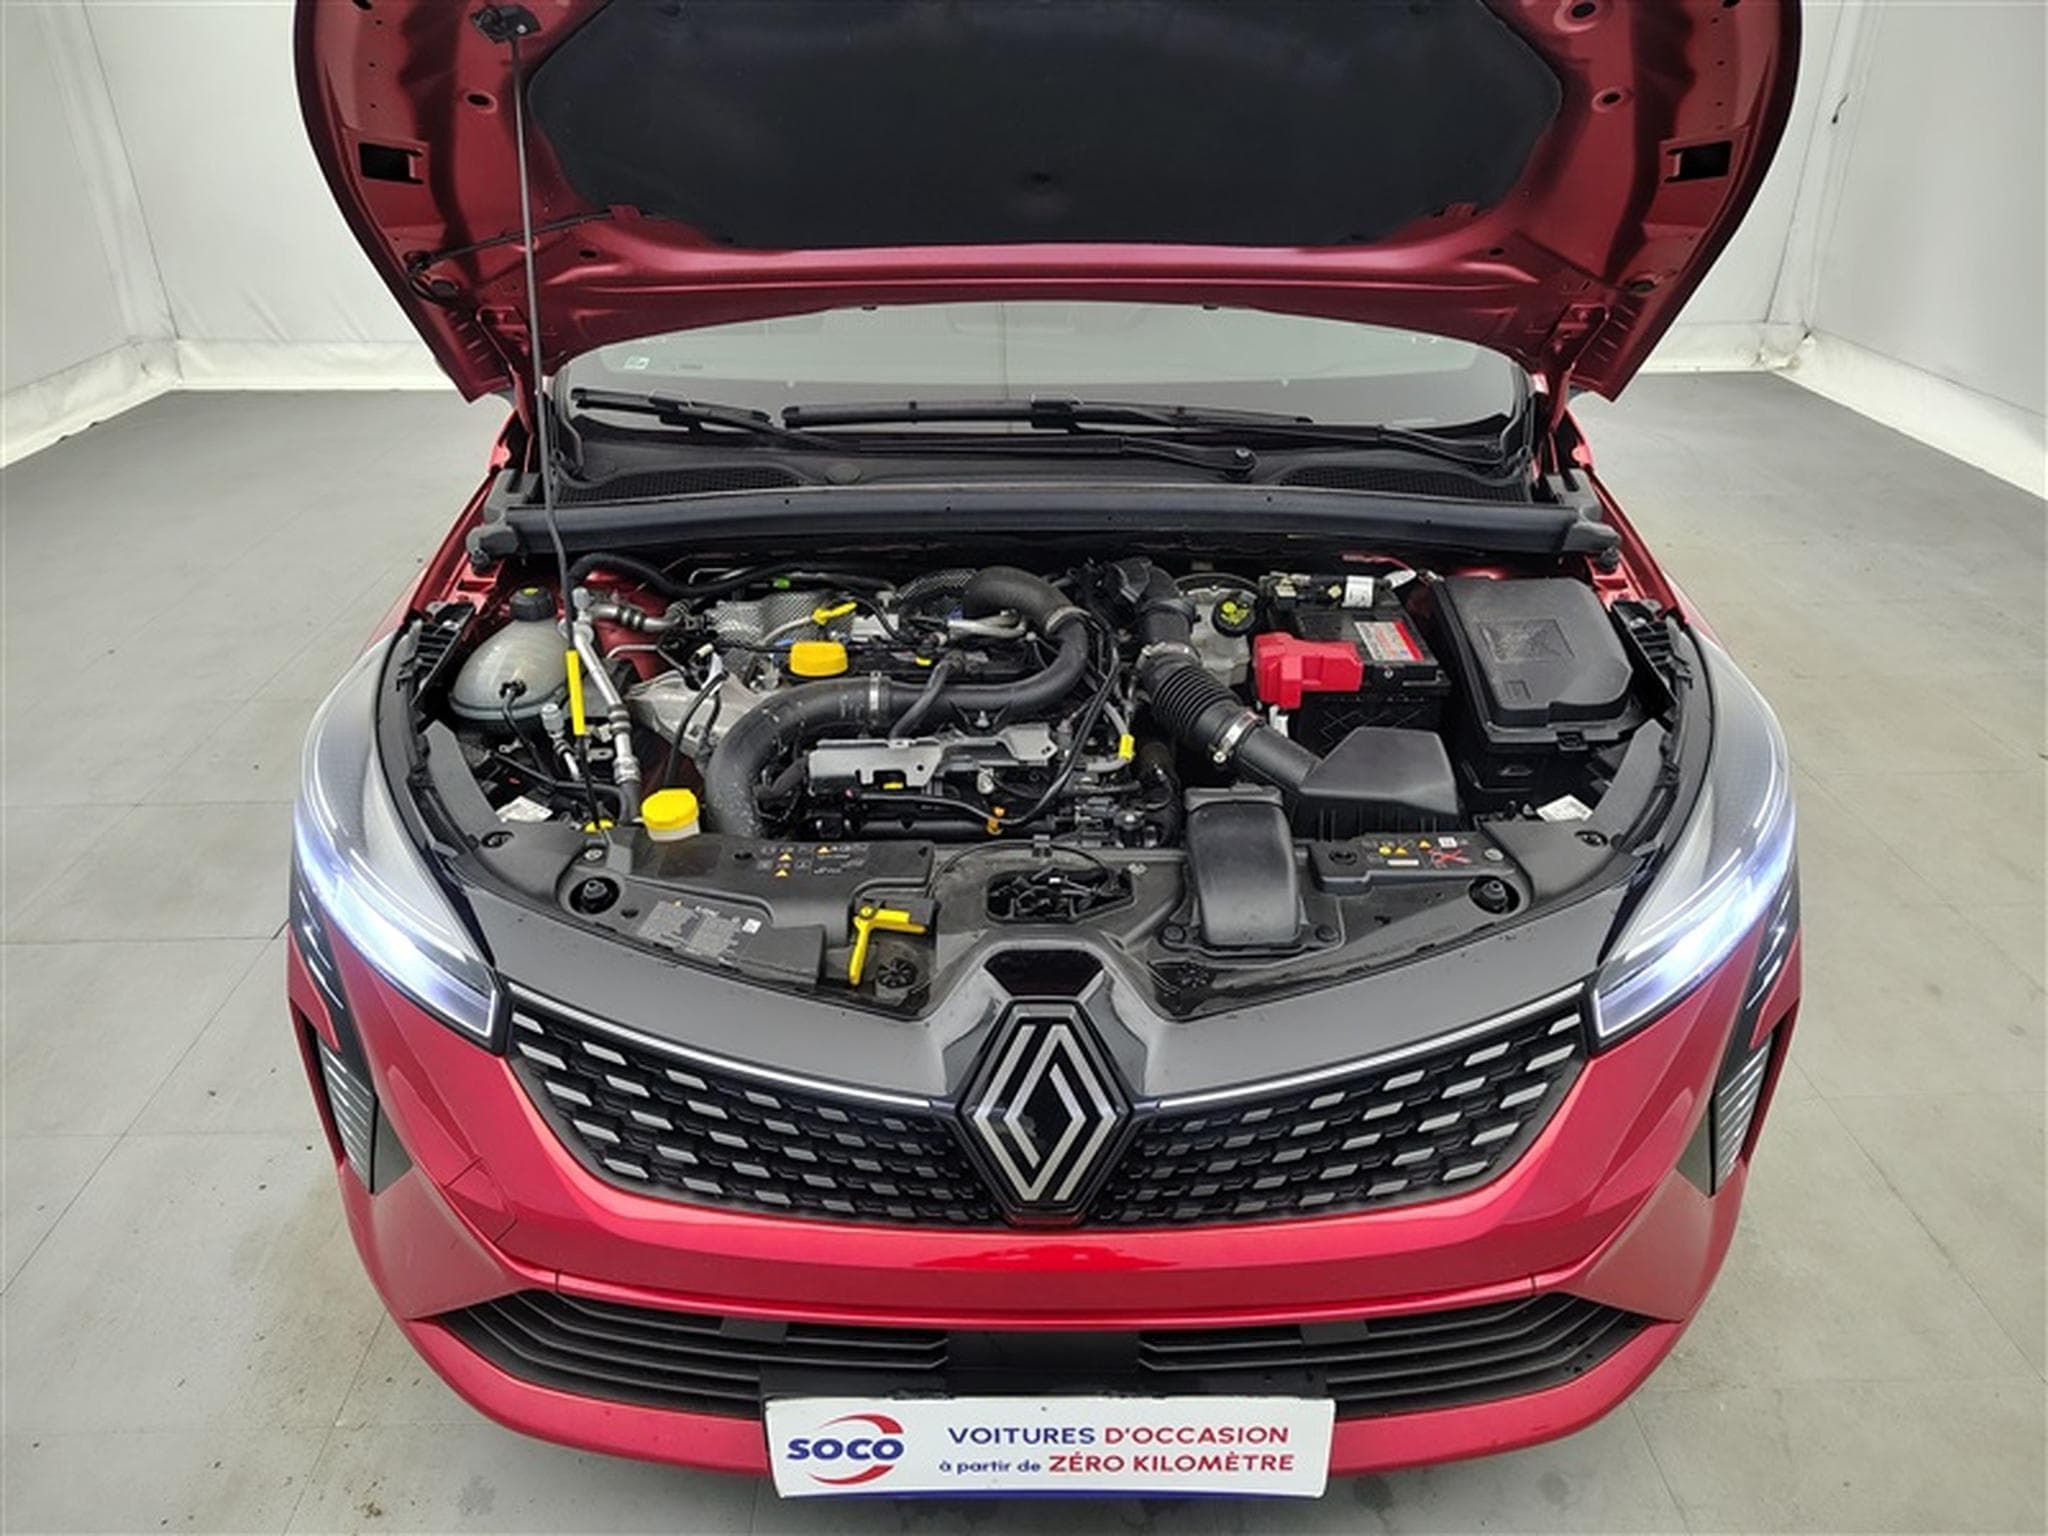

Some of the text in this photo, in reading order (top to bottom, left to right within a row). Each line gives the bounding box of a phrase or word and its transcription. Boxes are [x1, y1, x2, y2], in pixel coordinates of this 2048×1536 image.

[948, 1427, 1289, 1445] VOITURES D'OCCASION
[788, 1438, 904, 1462] SOCO
[939, 1452, 1294, 1476] à partir de ZÉRO KILOMÈTRE
